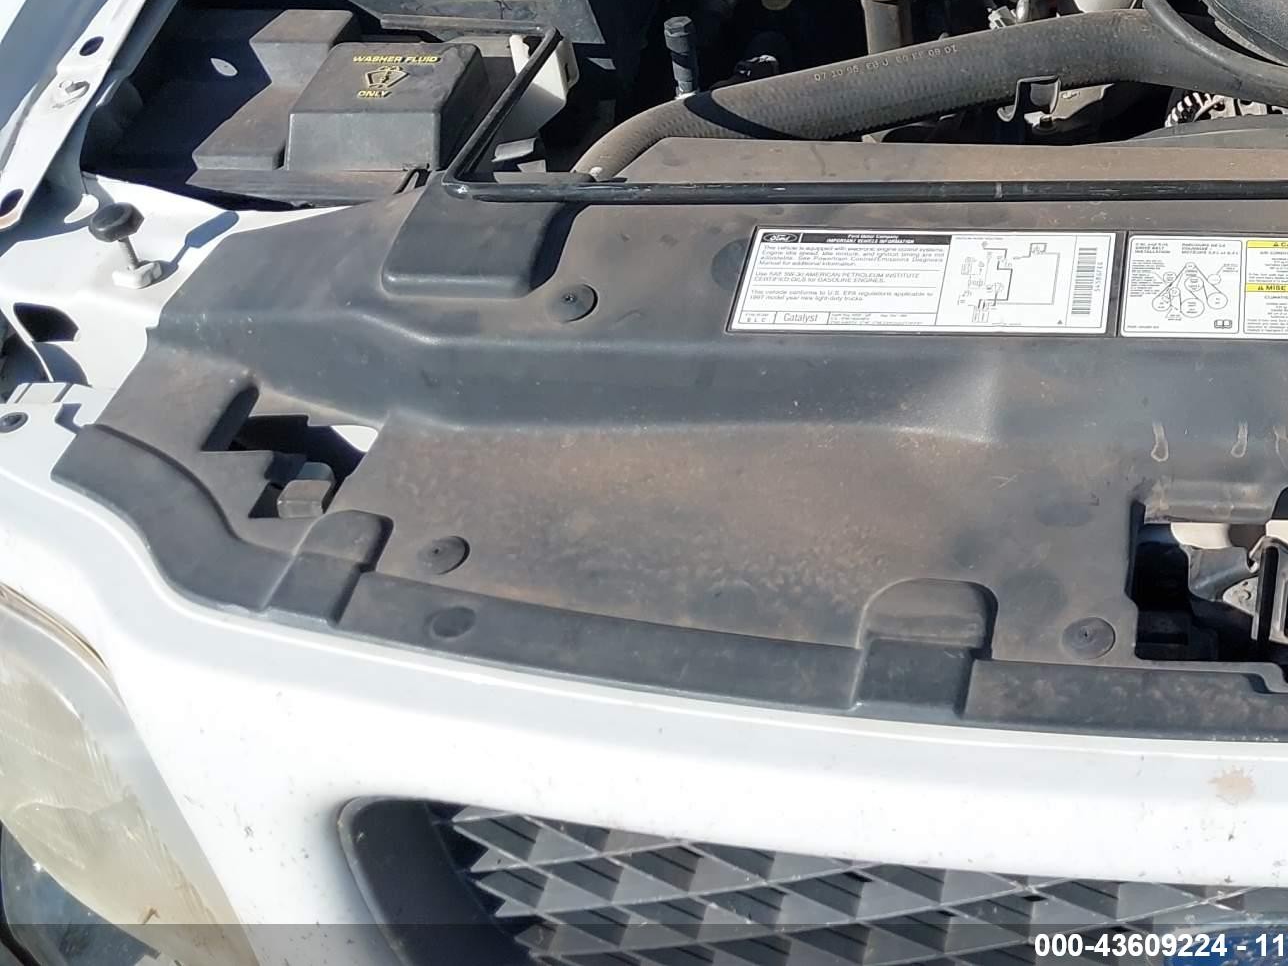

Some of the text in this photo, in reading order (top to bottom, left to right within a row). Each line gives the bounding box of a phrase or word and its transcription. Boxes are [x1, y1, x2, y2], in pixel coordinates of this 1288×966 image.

[352, 55, 440, 64] WASHER FLUID
[356, 90, 390, 98] ONLY
[783, 313, 818, 323] Catalyst
